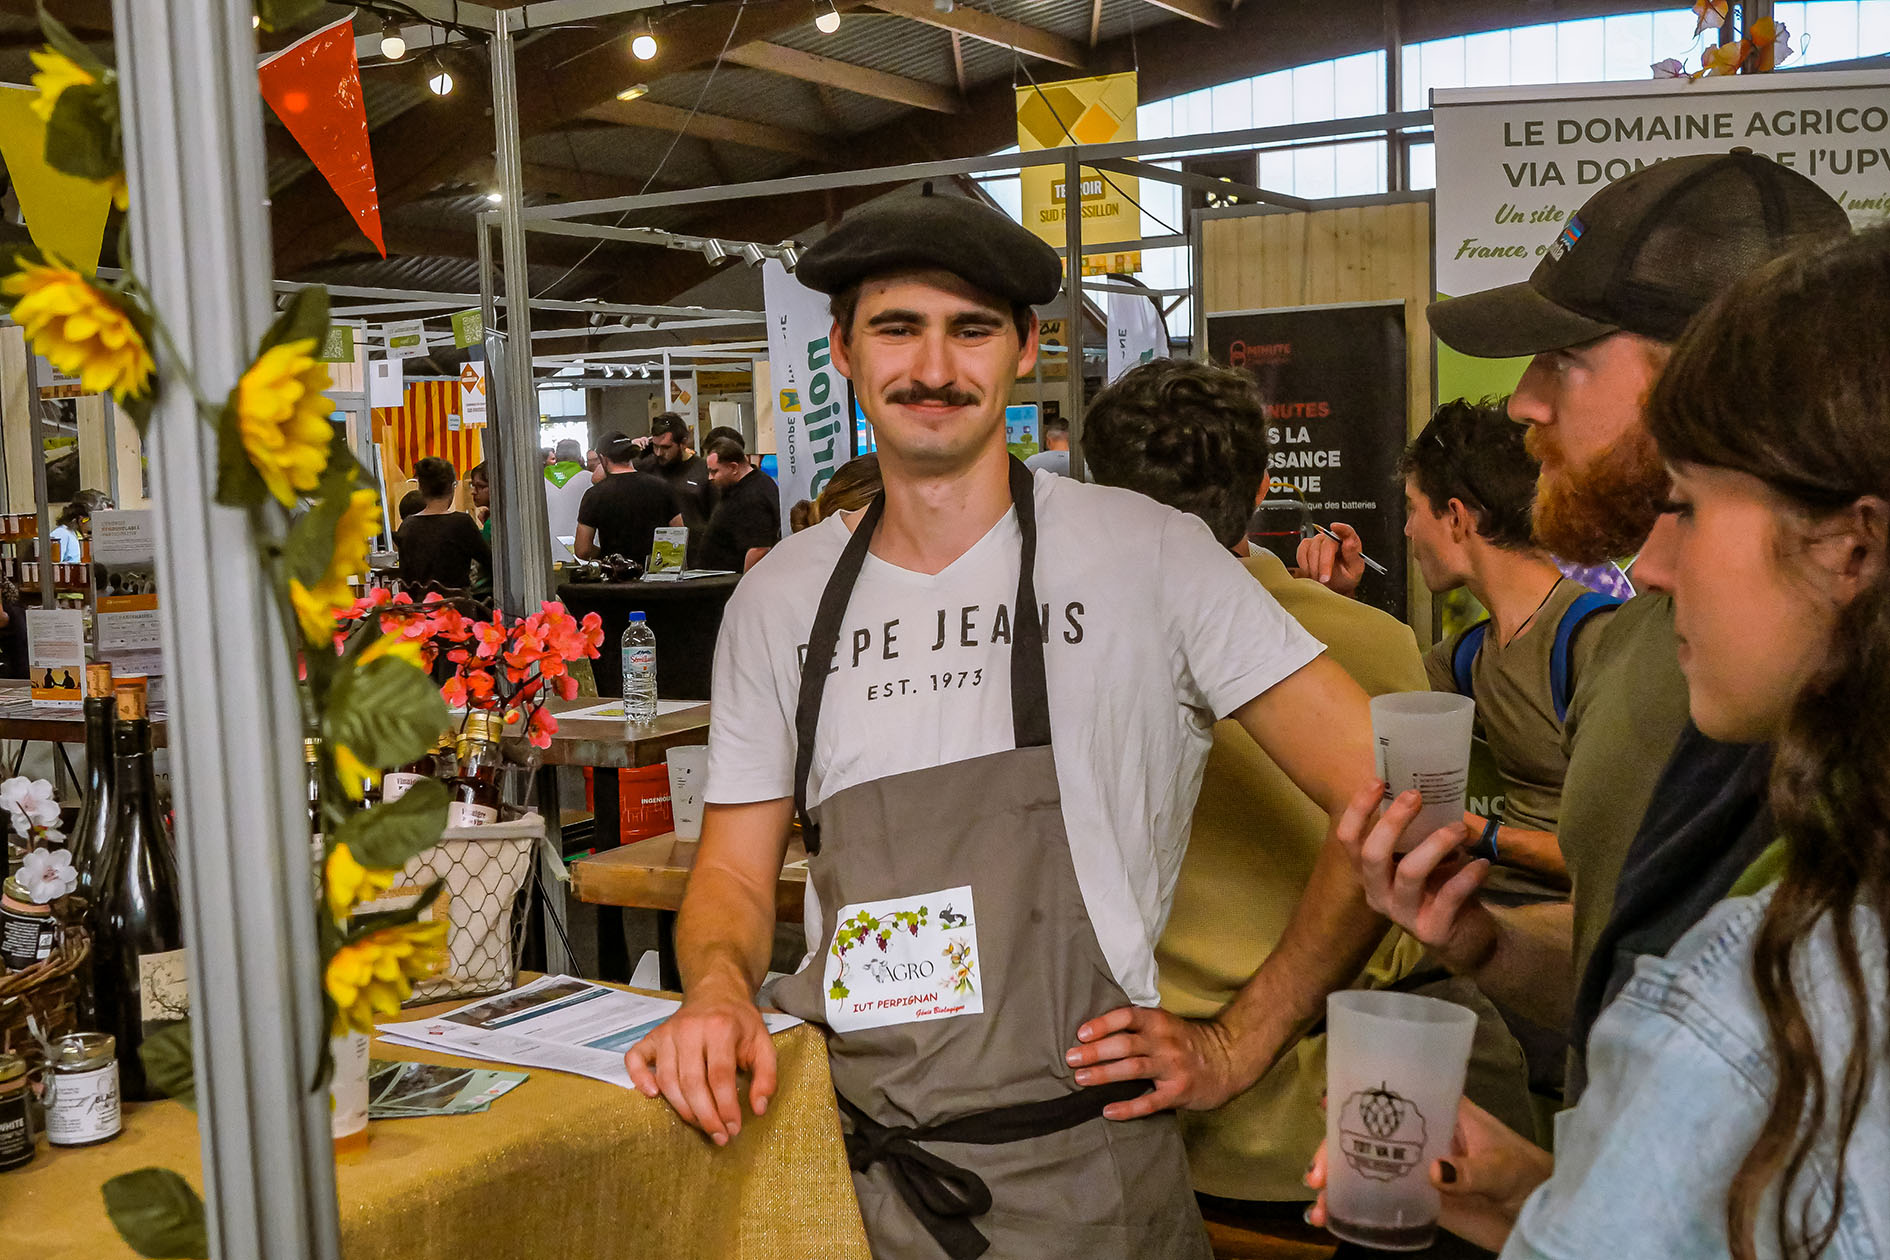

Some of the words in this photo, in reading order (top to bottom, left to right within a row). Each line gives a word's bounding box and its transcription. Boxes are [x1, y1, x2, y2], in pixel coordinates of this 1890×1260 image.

[1504, 121, 1545, 147] LE
[1557, 113, 1734, 145] DOMAINE
[1502, 161, 1566, 188] VIA
[1055, 181, 1102, 198] TEOIR
[1040, 209, 1059, 222] SUD
[1062, 203, 1119, 220] SSILLON
[1495, 203, 1524, 225] Un
[1529, 205, 1564, 224] site
[1454, 238, 1528, 260] France,
[1286, 427, 1311, 443] LA
[1324, 501, 1340, 510] des
[1342, 500, 1377, 510] batteries
[797, 618, 900, 675] PPE
[867, 679, 917, 701] EST.
[930, 668, 984, 691] 1973
[853, 1002, 874, 1013] IUT
[877, 992, 938, 1009] PERPIGNAN
